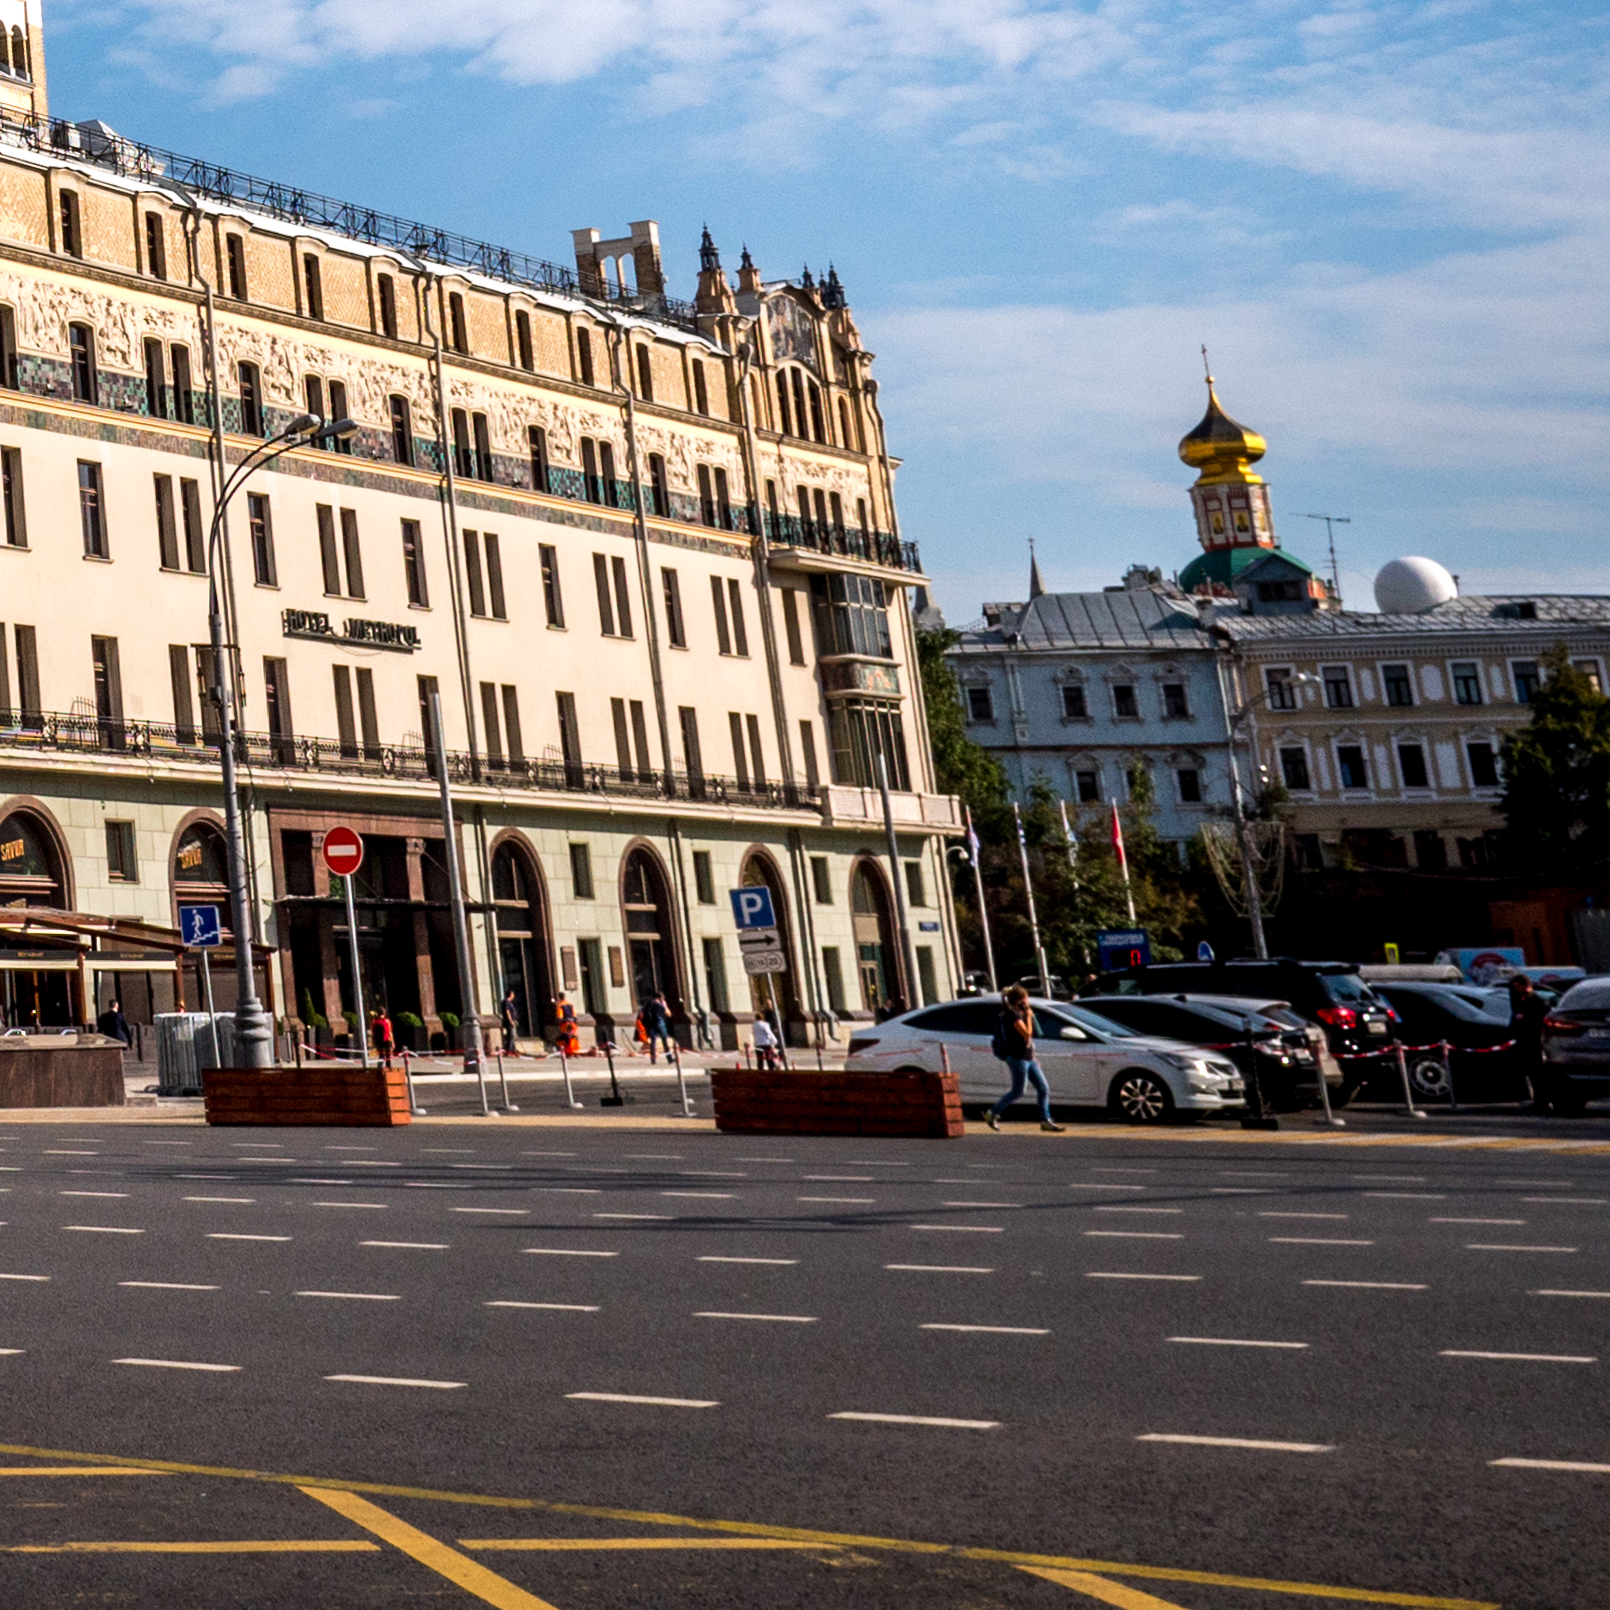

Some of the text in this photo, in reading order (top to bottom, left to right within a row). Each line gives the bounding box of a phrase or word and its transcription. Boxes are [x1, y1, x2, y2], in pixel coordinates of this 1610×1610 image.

[281, 608, 421, 646] HOTEL METROPOL
[0, 839, 25, 861] SAVVA
